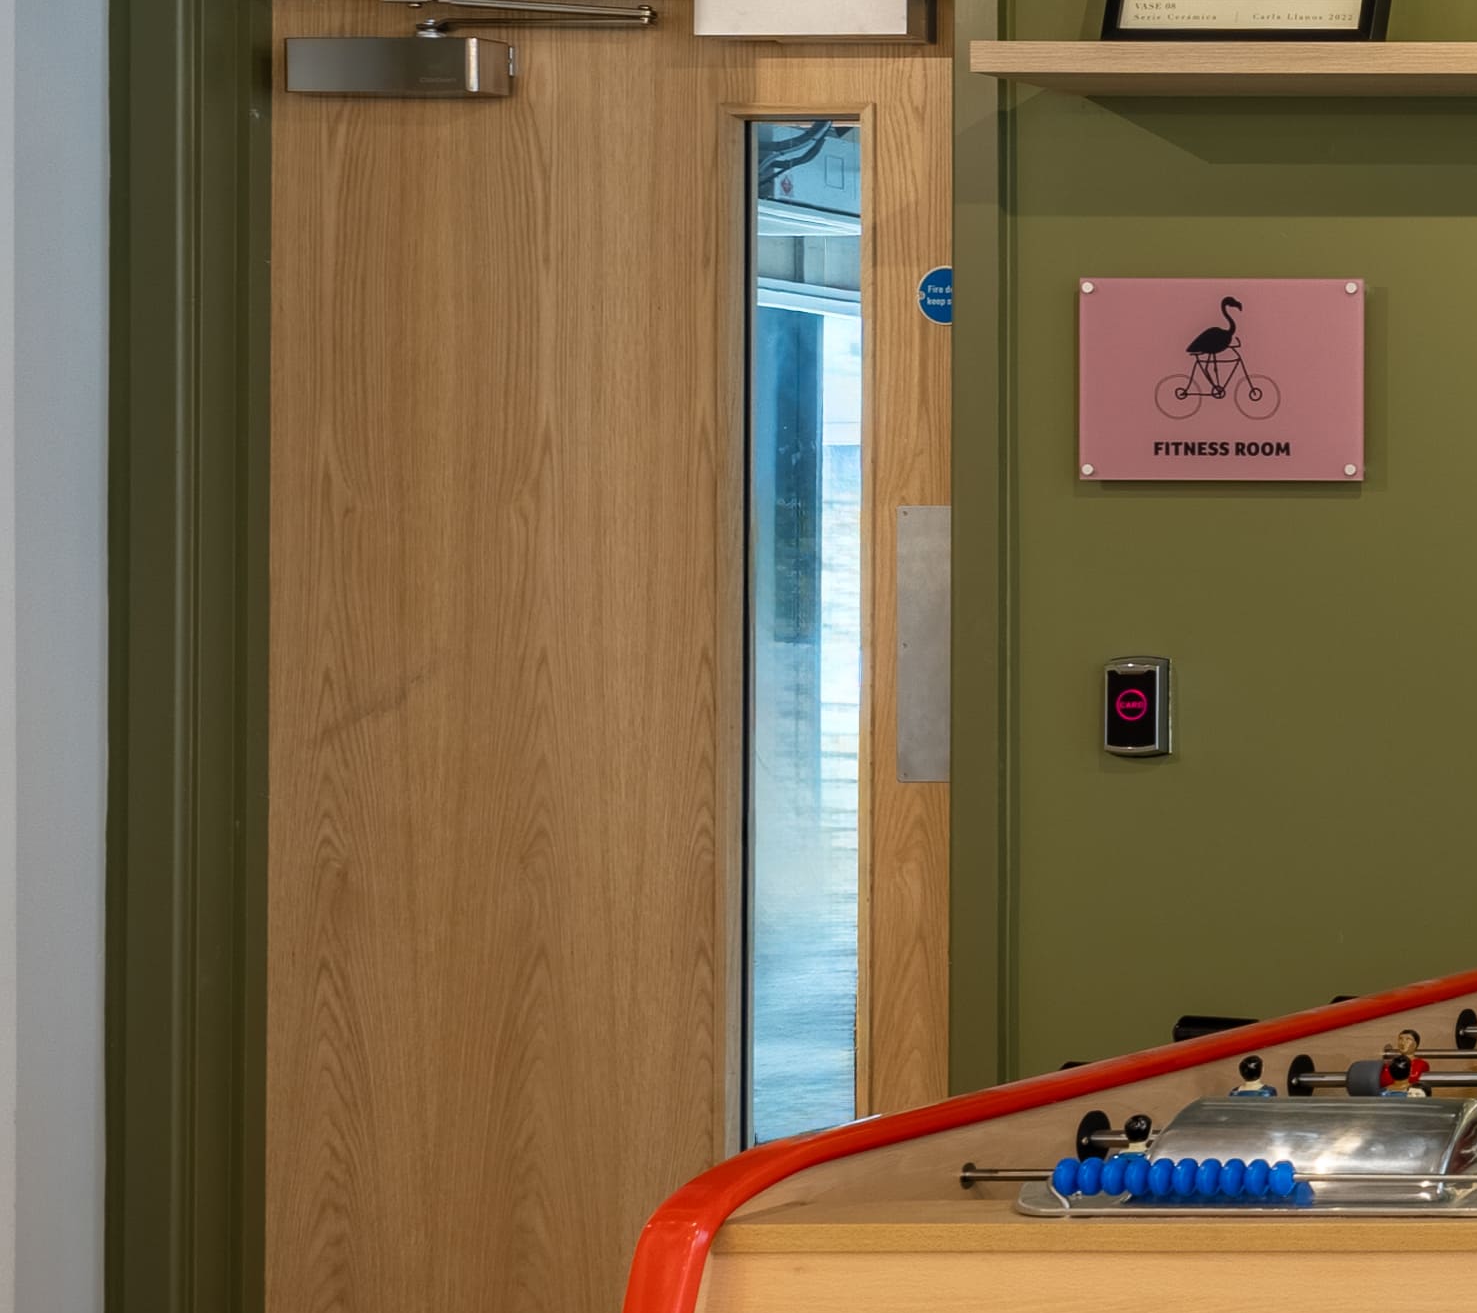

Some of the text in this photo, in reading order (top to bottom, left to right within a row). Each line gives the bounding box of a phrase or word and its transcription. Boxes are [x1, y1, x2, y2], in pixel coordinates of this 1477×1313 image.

[928, 285, 944, 294] Fire
[927, 296, 945, 306] keep
[1153, 441, 1291, 456] FITNESS ROOM
